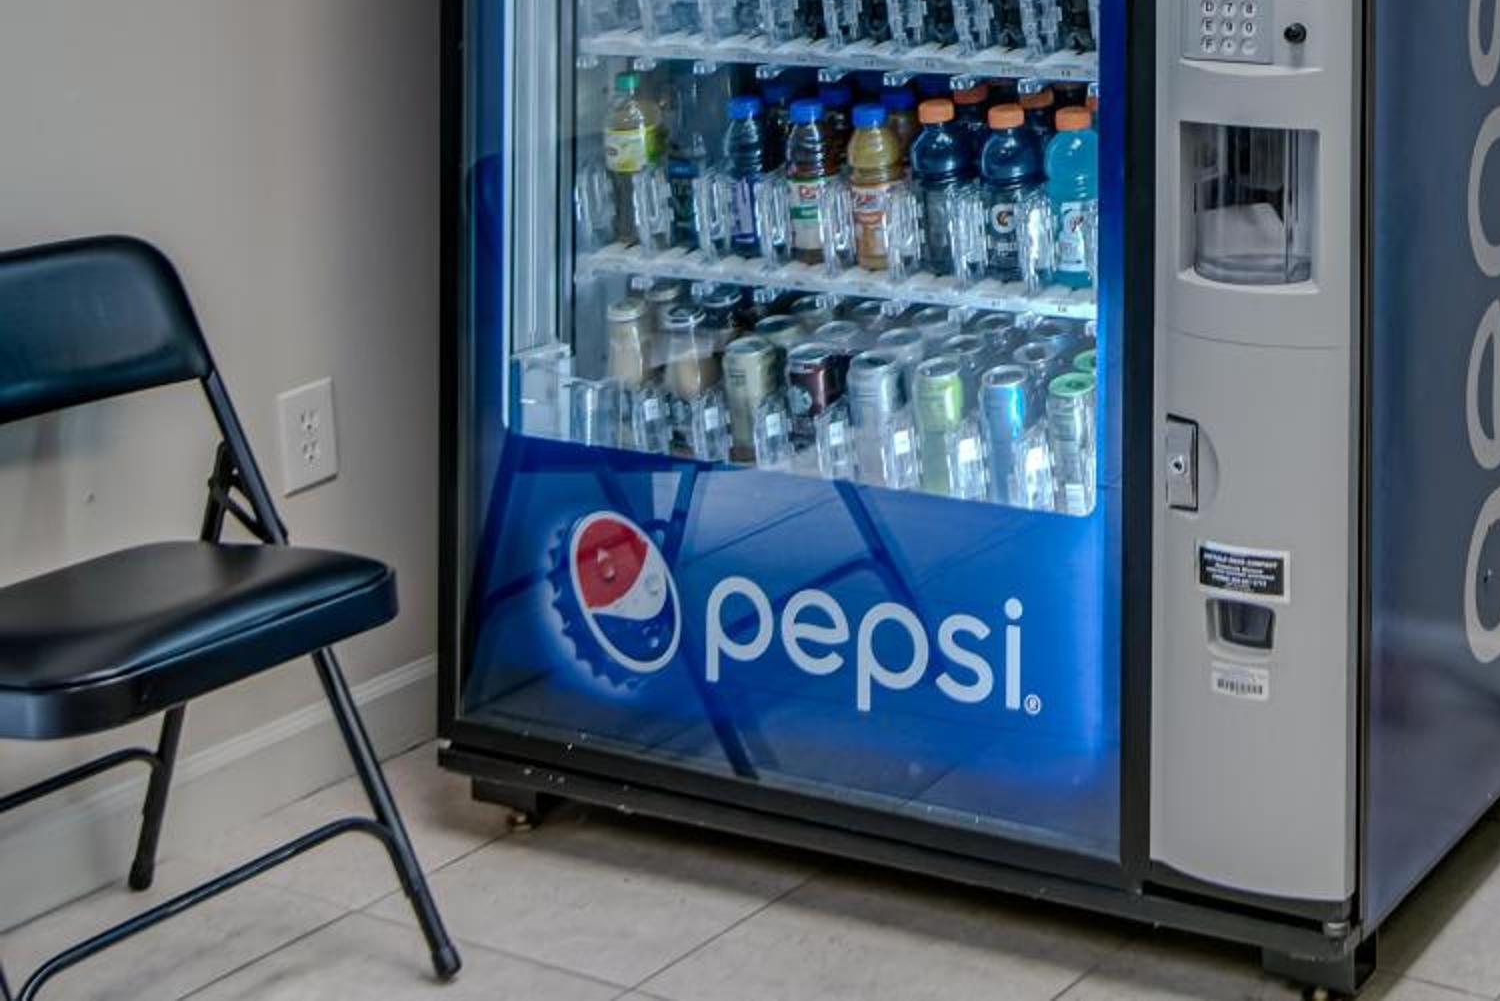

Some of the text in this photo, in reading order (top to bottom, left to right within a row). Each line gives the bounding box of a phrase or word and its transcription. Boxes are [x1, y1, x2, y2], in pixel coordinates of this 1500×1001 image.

[1205, 1, 1253, 14] D 7 8
[1205, 20, 1253, 33] E 9 0
[1205, 39, 1213, 50] F
[705, 574, 1024, 712] pepsi
